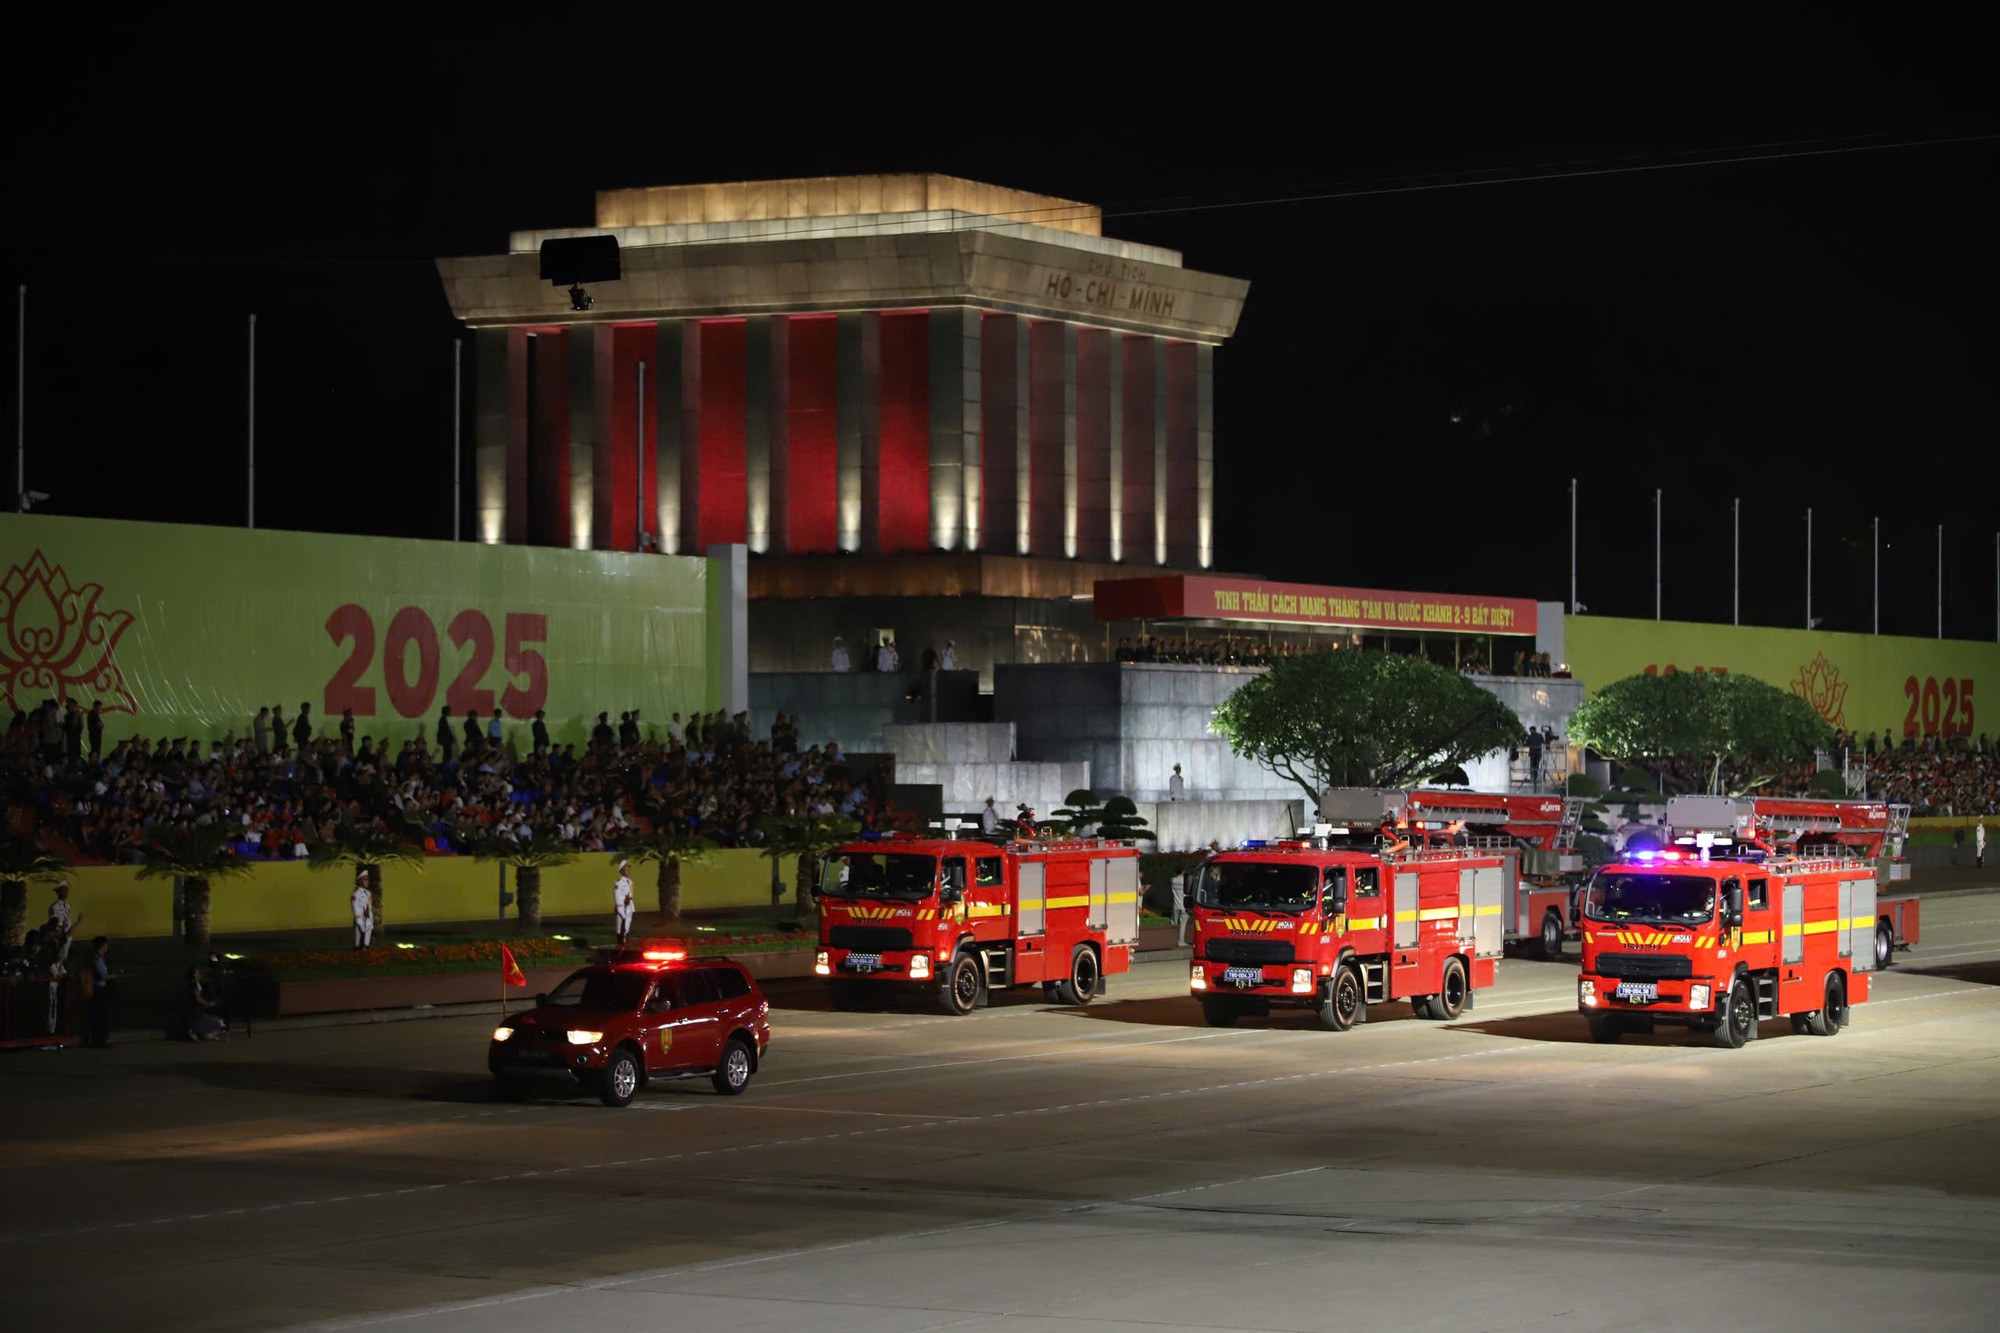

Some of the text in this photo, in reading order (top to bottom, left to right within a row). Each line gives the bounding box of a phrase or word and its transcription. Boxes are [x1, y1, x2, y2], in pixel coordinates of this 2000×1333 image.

[1214, 590, 1240, 611] TINH
[1272, 590, 1298, 614] CÁCH
[1299, 595, 1327, 619] MẠNG
[324, 603, 549, 719] 2025
[1903, 676, 1975, 738] 2025
